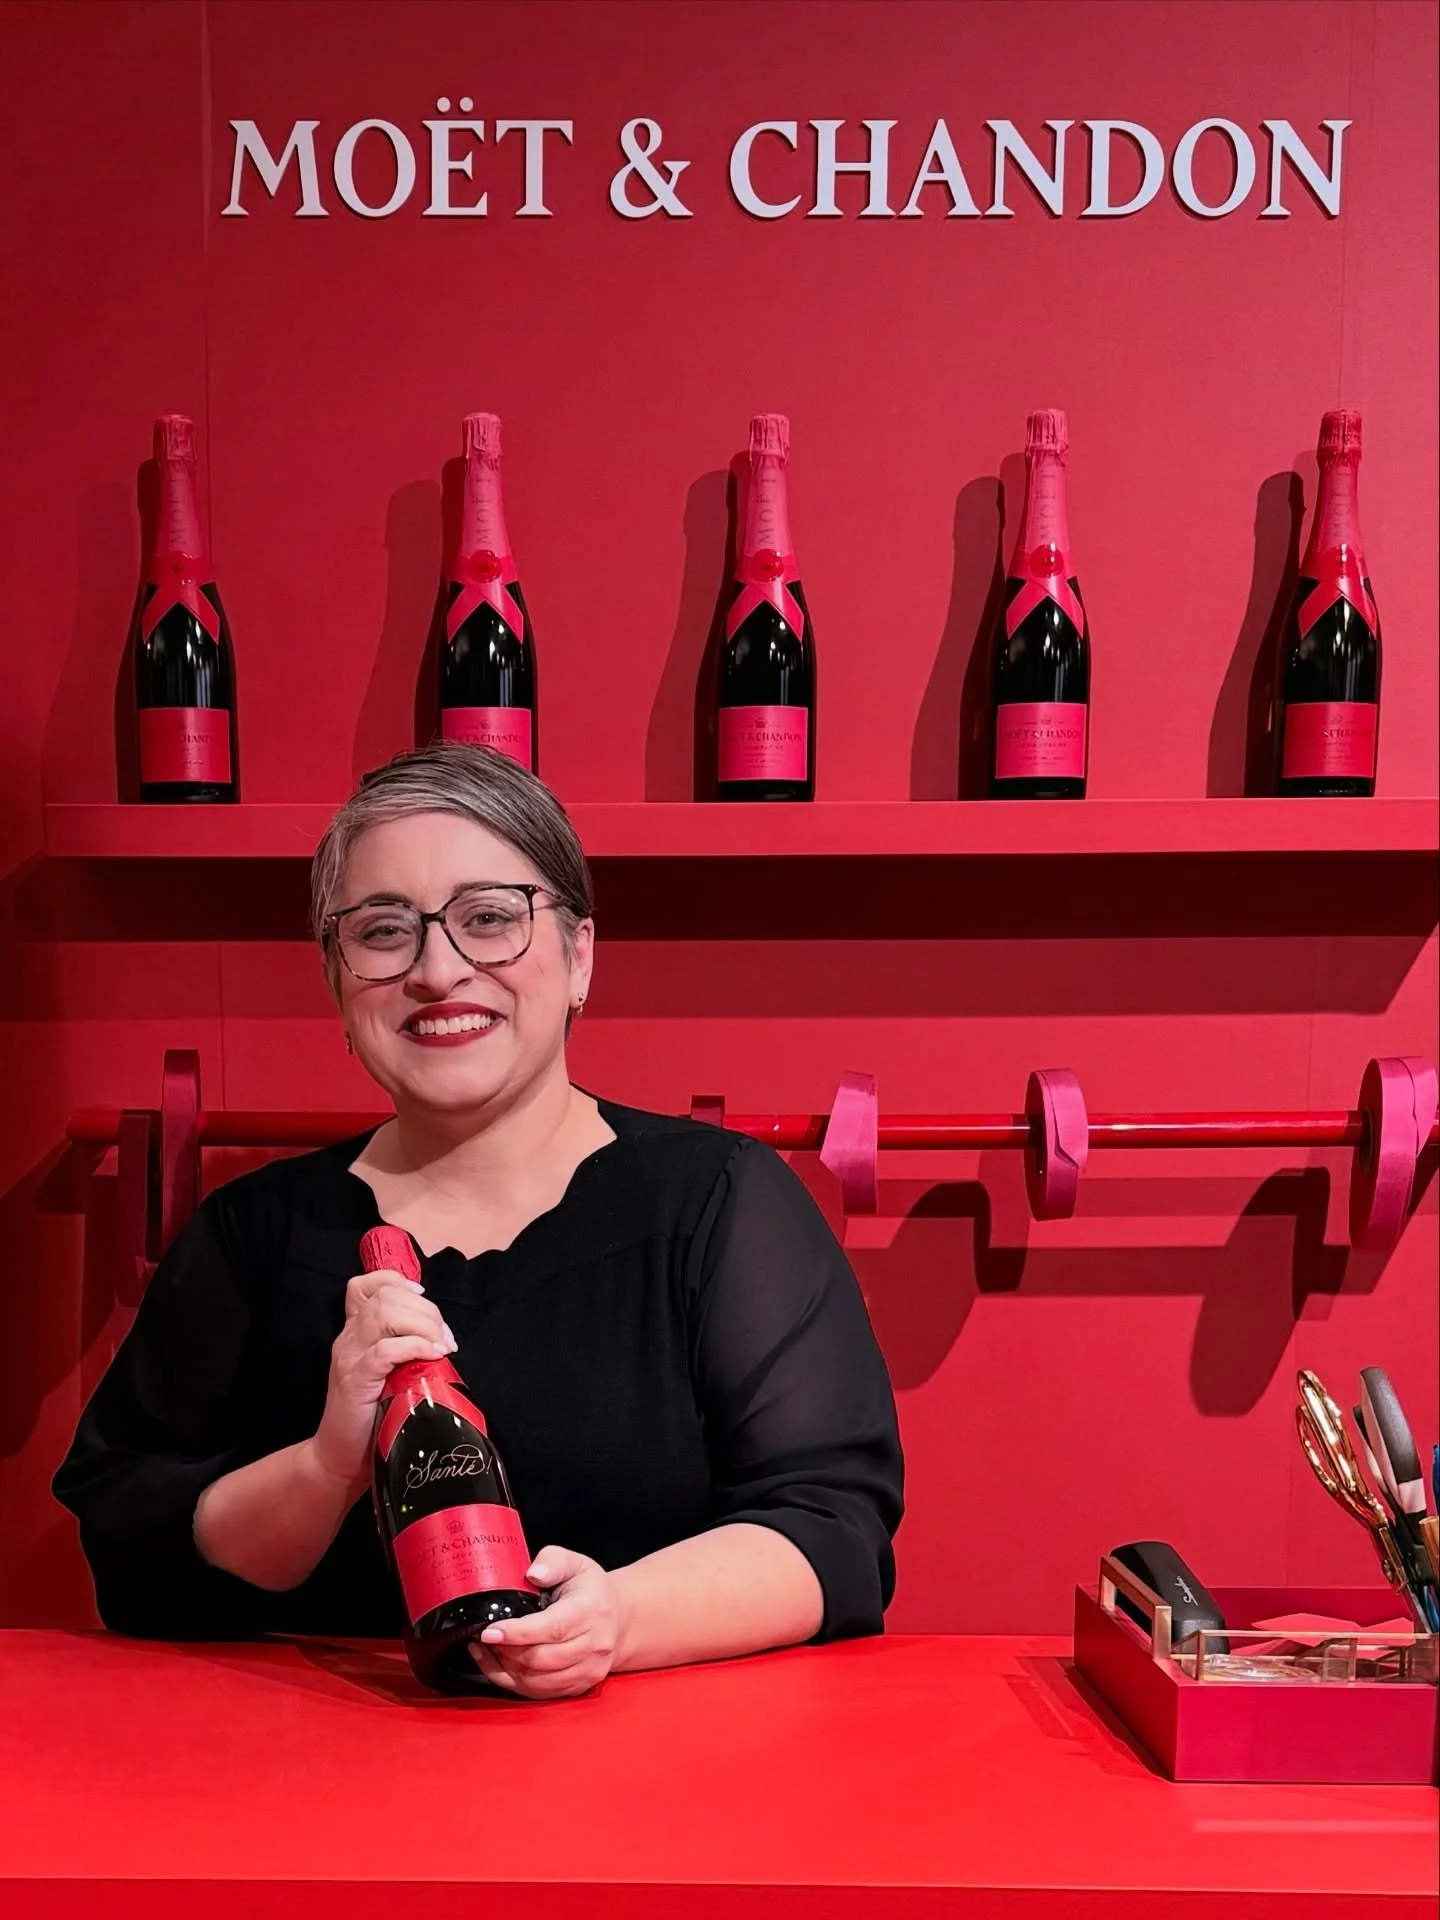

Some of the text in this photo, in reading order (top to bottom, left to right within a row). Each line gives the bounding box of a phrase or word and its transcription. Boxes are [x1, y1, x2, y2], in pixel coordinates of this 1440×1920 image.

[220, 97, 1352, 219] MOËT & CHANDON
